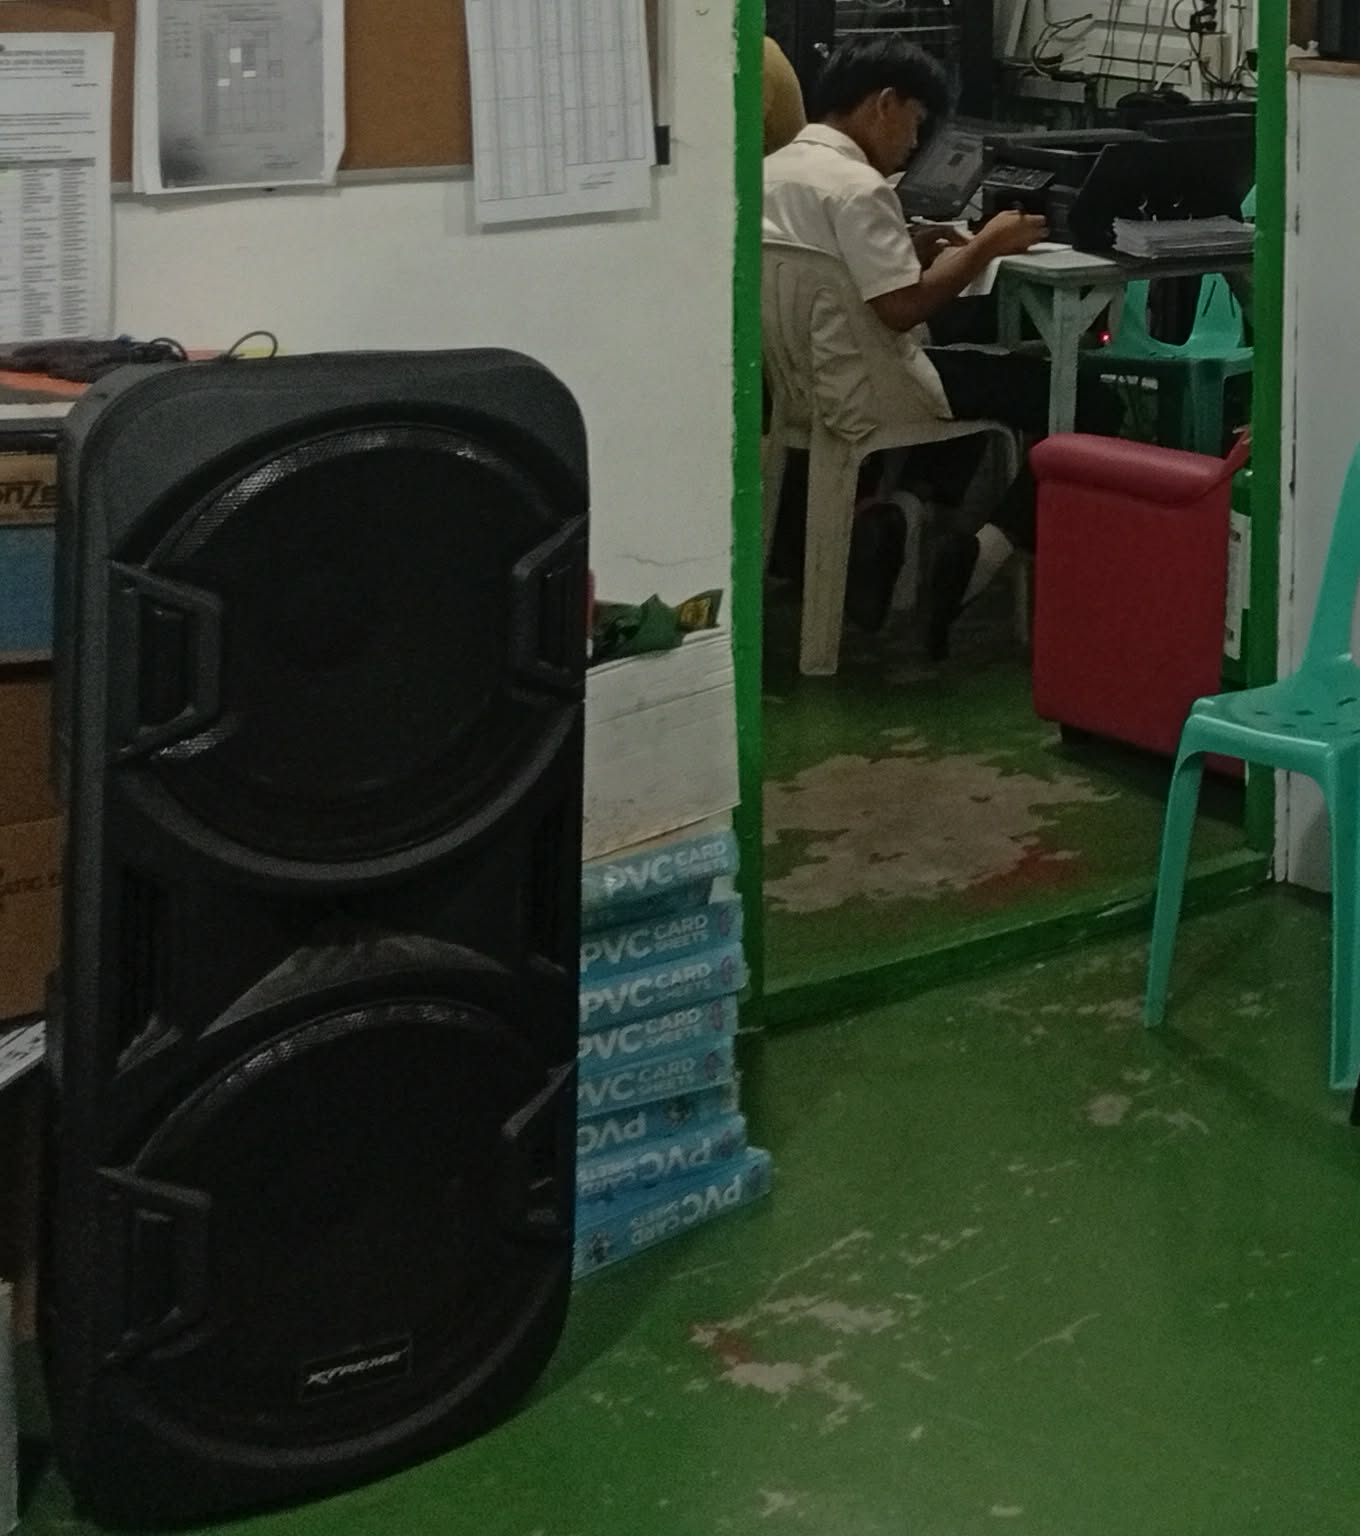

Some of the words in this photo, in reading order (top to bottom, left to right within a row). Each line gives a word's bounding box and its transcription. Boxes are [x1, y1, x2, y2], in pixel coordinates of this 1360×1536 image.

[604, 854, 674, 897] PVC
[674, 839, 728, 866] CARD
[580, 928, 652, 973] PVC
[654, 914, 709, 939] CARD
[579, 977, 655, 1024] PVC
[655, 962, 713, 989] CARD
[644, 1007, 703, 1034] CARD
[639, 1057, 697, 1082] CARD
[576, 1111, 647, 1155] PVC
[638, 1137, 712, 1180] PVC
[680, 1173, 743, 1226] PVC
[631, 1214, 682, 1245] CARD
